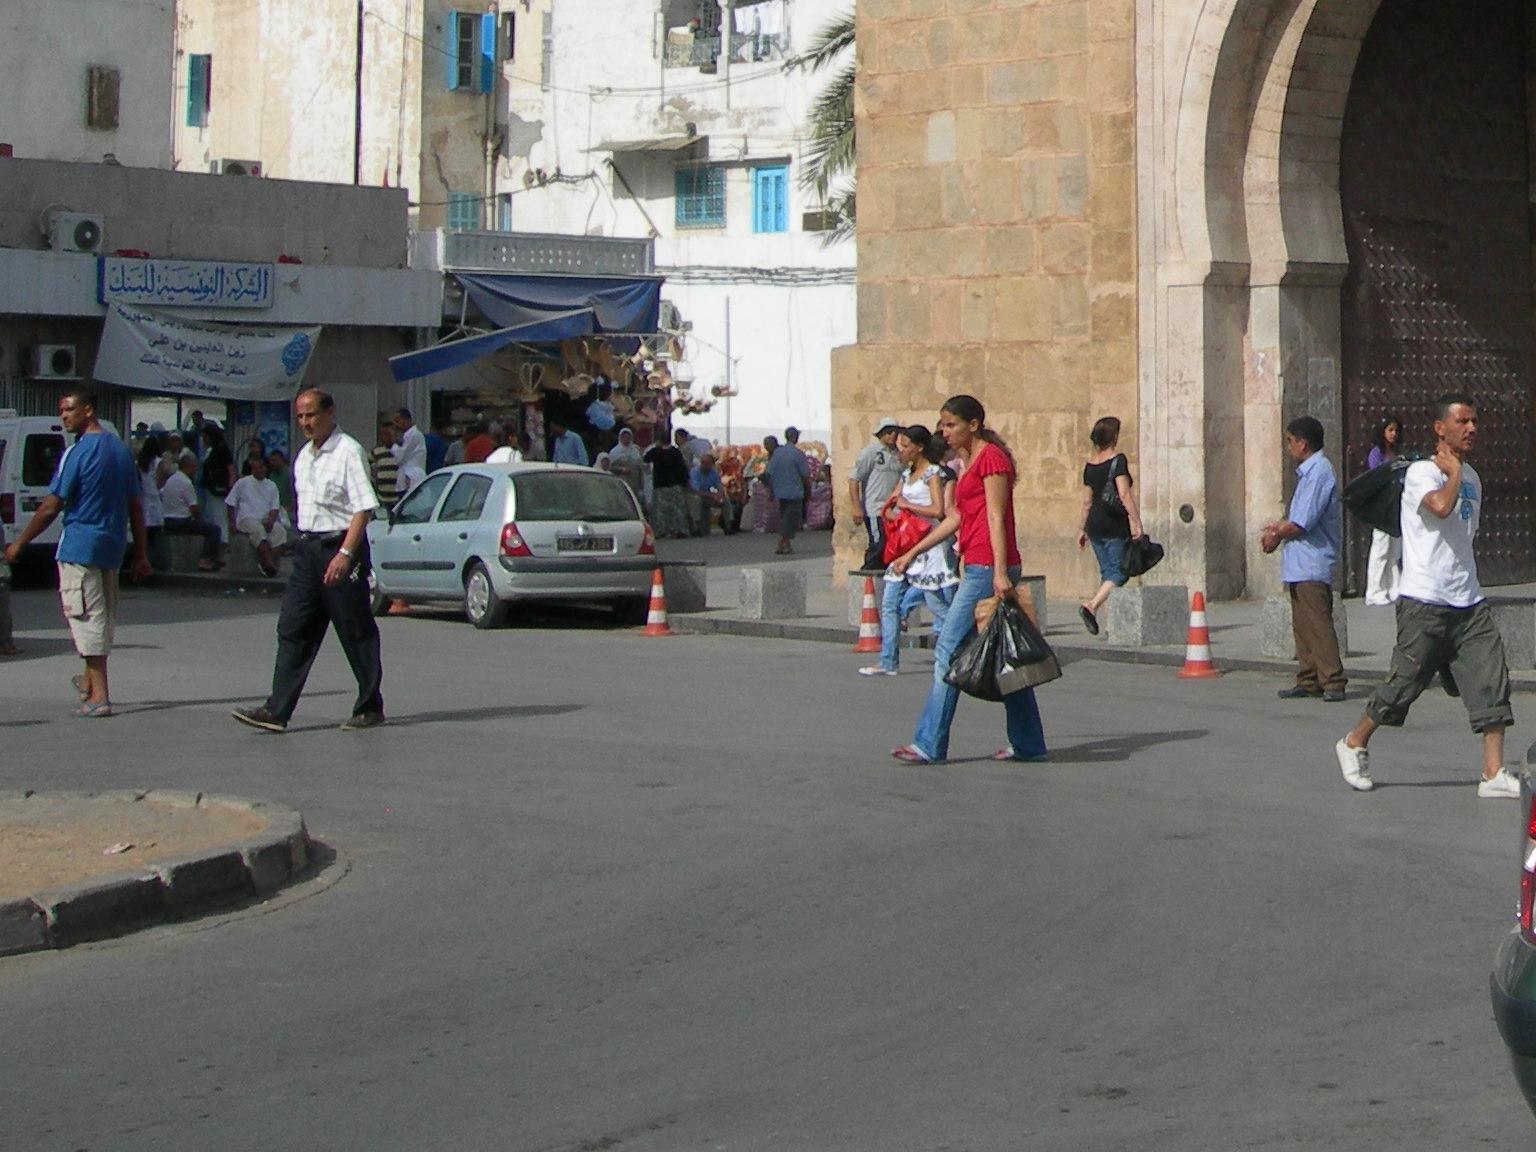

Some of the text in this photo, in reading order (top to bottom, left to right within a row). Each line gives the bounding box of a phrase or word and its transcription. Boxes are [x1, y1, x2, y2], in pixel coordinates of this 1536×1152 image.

[109, 262, 269, 302] الشركة التونسية للبنك
[876, 451, 886, 465] 3
